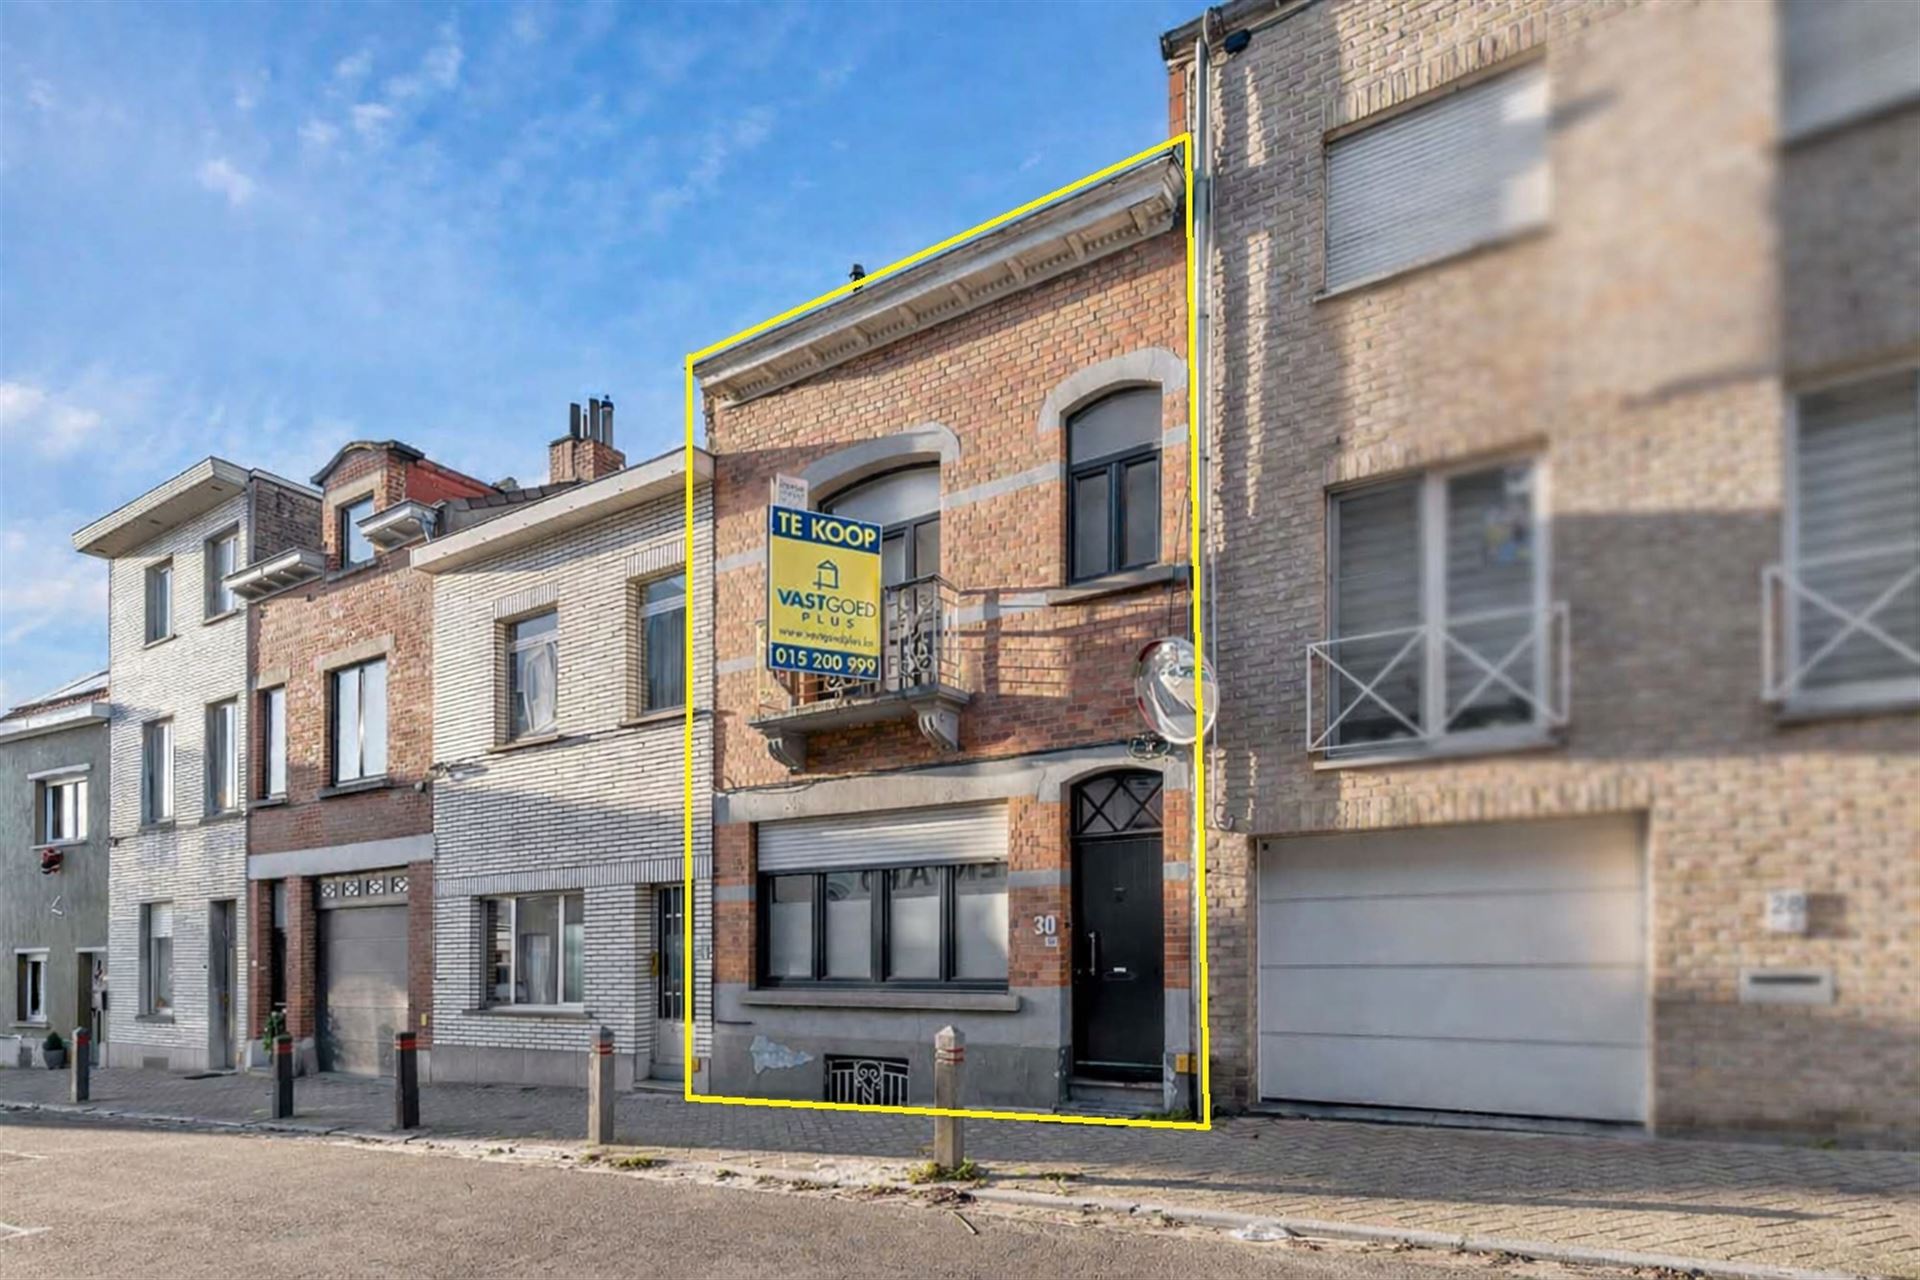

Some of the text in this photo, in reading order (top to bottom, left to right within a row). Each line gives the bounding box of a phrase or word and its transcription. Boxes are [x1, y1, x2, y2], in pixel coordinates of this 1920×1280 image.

[777, 511, 877, 549] TE KOOP
[777, 587, 877, 618] VASTGOED
[801, 611, 855, 629] PLUS
[775, 647, 877, 675] 015 200 999
[1033, 914, 1056, 936] 30
